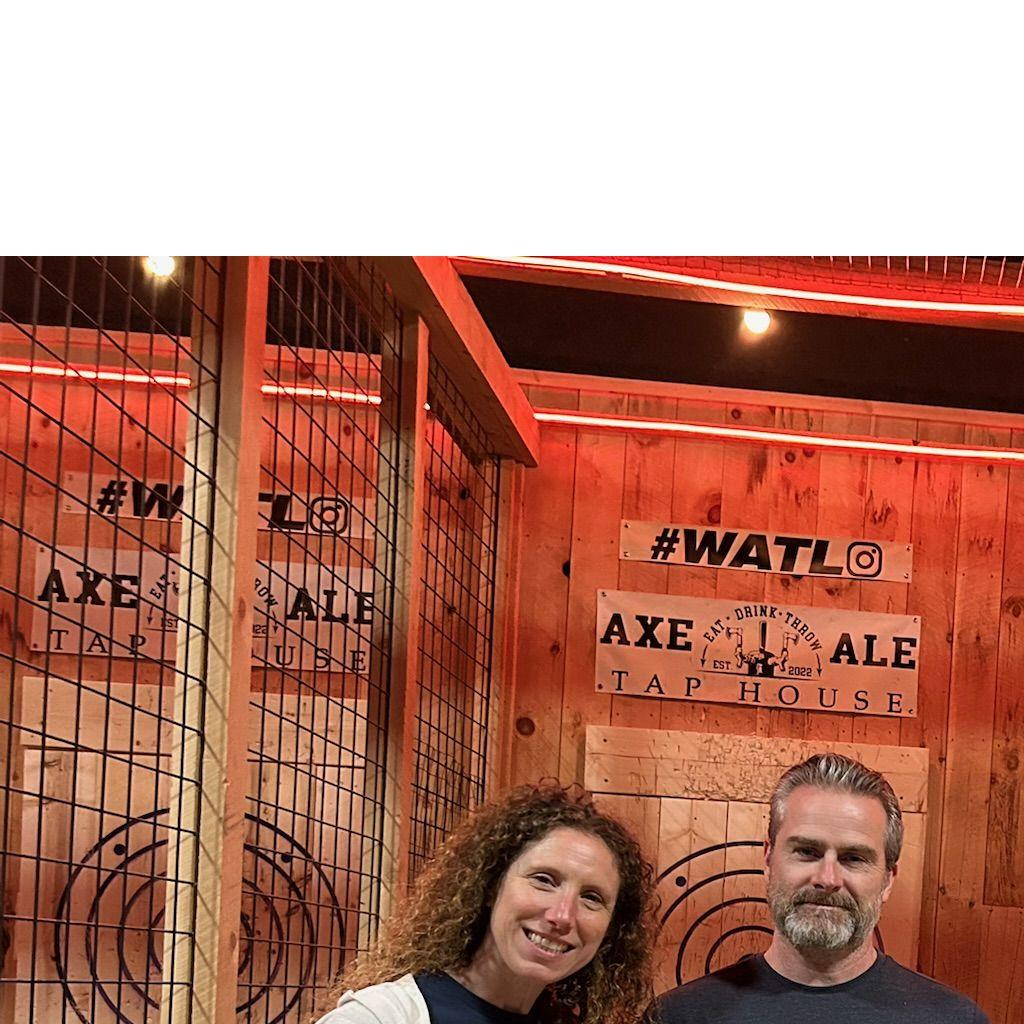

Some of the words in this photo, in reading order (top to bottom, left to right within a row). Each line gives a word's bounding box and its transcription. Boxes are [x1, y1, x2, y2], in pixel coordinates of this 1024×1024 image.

[651, 528, 844, 574] #WATL
[38, 569, 139, 608] AXE
[286, 588, 373, 624] ALE
[50, 629, 147, 655] TAP
[600, 613, 694, 651] AXE
[830, 633, 917, 670] ALE
[703, 619, 725, 643] EAT
[734, 605, 777, 620] DRINK
[785, 612, 822, 651] THROW
[611, 670, 701, 697] TAP
[739, 681, 903, 713] HOUSE
[789, 666, 812, 676] 2022
